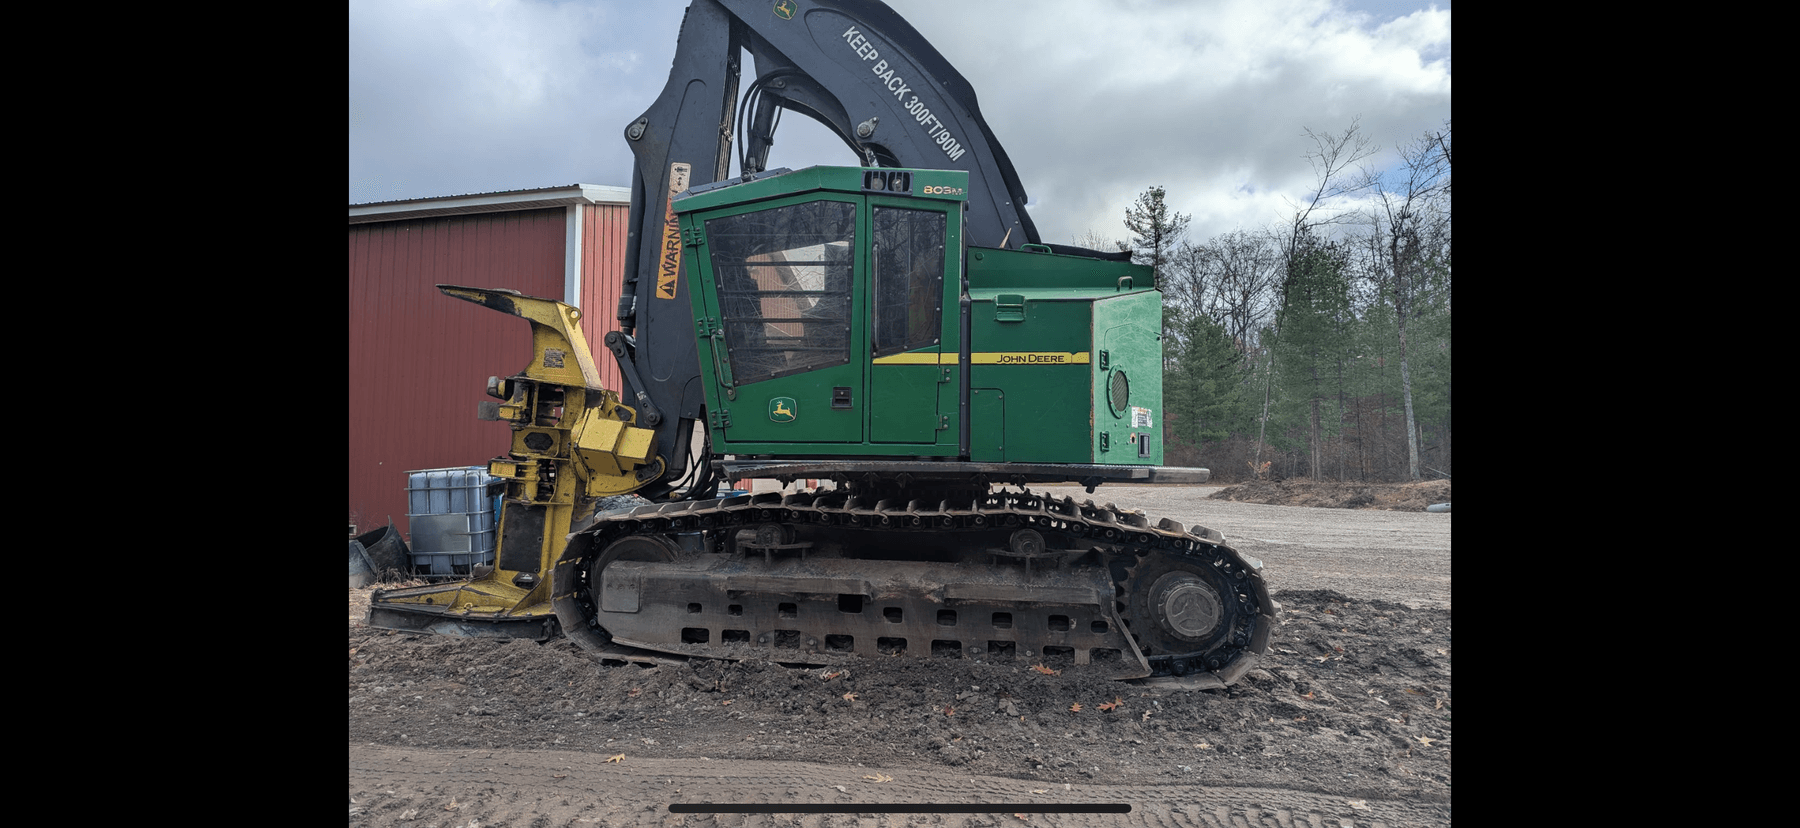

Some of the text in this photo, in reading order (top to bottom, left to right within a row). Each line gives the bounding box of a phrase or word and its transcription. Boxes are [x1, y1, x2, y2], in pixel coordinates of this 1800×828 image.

[842, 26, 966, 161] KEEP BACK 300FT/90M
[923, 185, 963, 195] 803M
[663, 212, 680, 277] WARNIN
[996, 354, 1065, 363] JOHN DEERE
